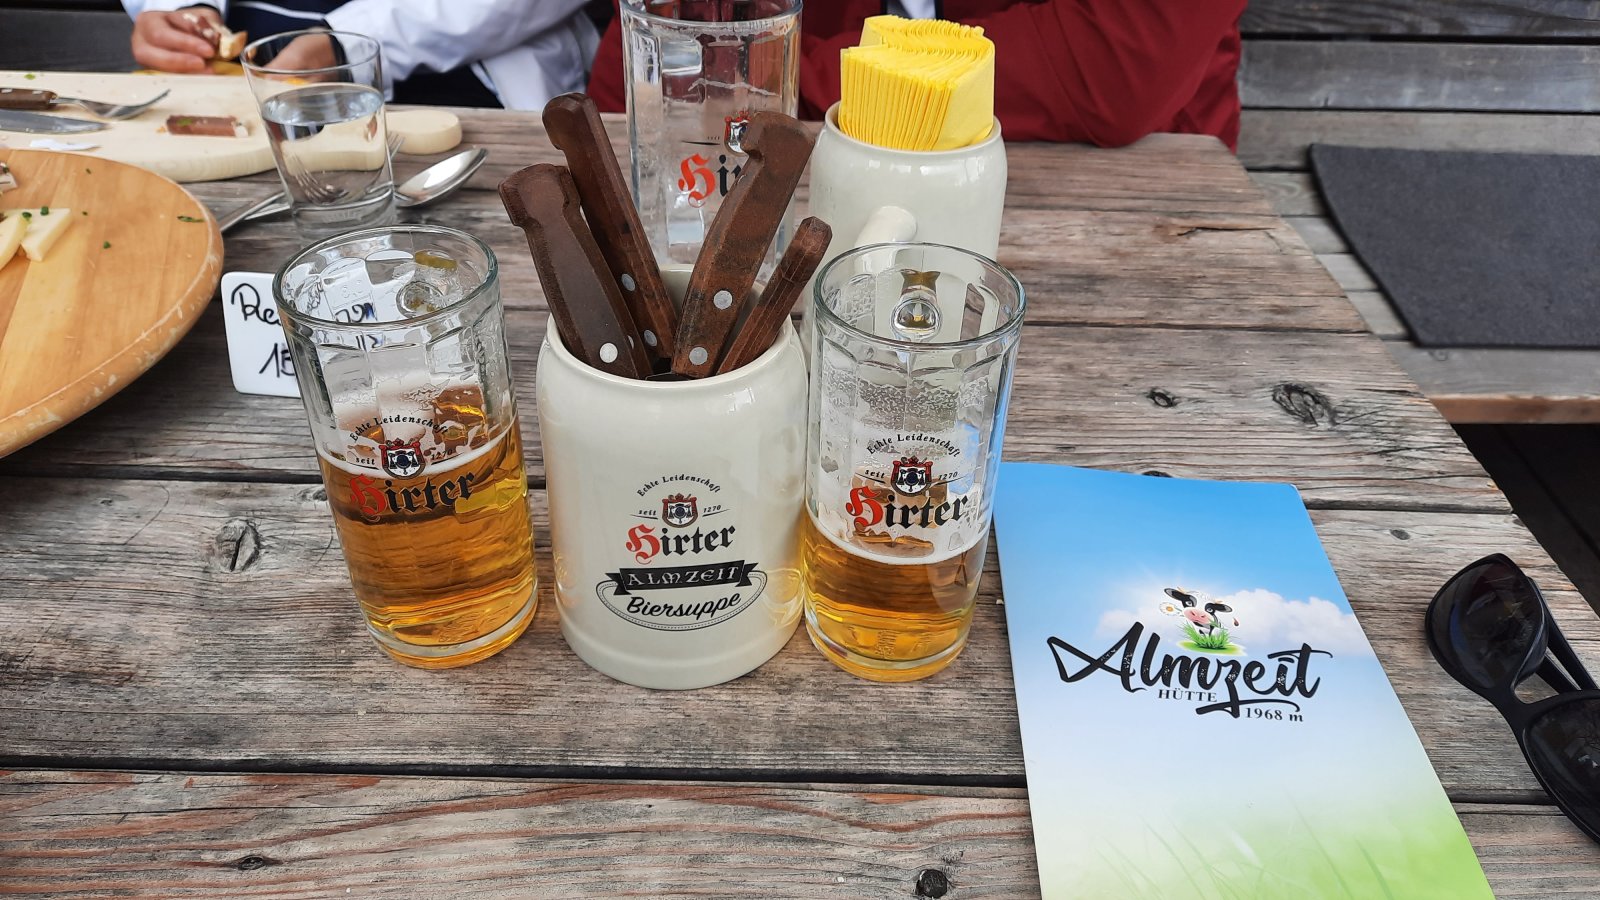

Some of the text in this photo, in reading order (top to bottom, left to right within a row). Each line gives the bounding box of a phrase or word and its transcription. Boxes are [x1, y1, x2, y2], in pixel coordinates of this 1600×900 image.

[678, 153, 742, 208] Hi
[231, 283, 282, 326] Re
[349, 414, 449, 443] Echte Leidenschaft
[866, 433, 961, 458] Echte Leidenschaft
[355, 457, 376, 466] seit
[864, 469, 958, 481] seit 1270
[349, 472, 475, 523] Hirter
[636, 473, 721, 498] Echte Leidenschaft
[703, 504, 722, 513] 1270
[845, 486, 969, 532] Hirter
[625, 523, 736, 565] Hirter
[626, 566, 739, 587] ALMZEIT
[626, 592, 742, 621] Biersuppe
[1046, 621, 1333, 718] Almzeit
[1157, 688, 1218, 703] HÜTTE
[1245, 706, 1304, 723] 1968 m
